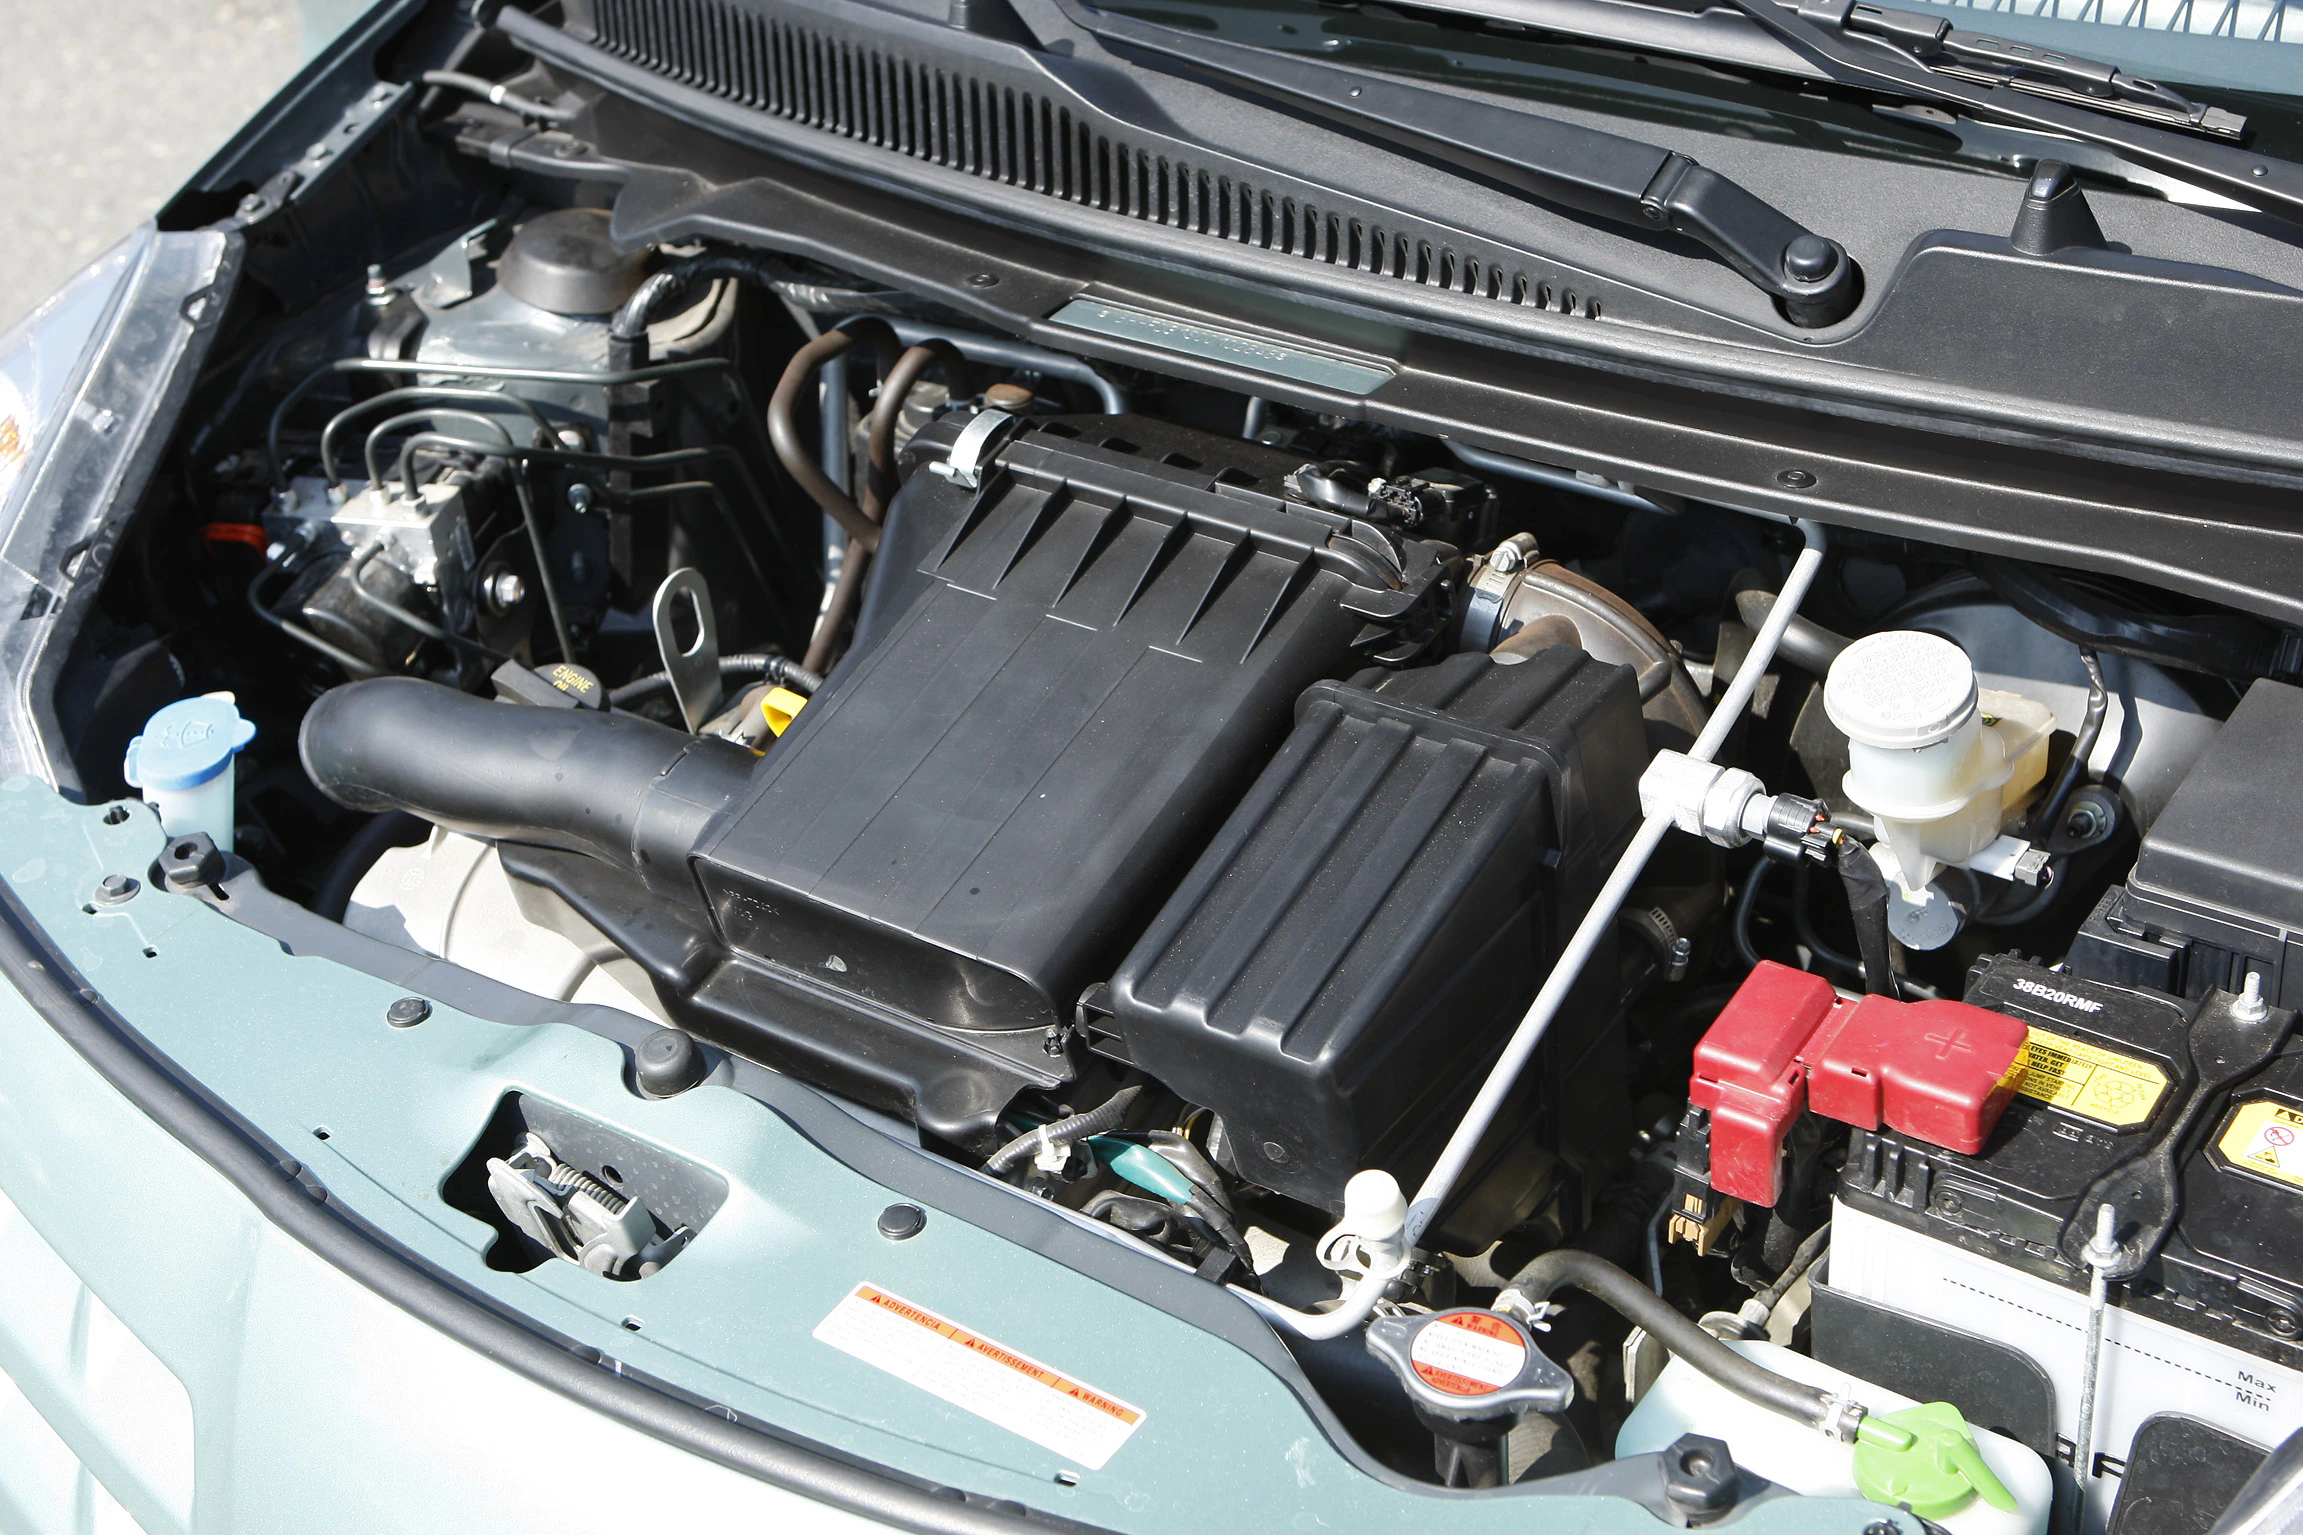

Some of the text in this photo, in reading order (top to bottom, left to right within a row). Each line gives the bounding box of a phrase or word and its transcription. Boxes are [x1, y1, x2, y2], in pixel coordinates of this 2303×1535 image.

[552, 664, 594, 694] ENGINE
[2013, 978, 2104, 1014] 38B20RMF
[2030, 1045, 2048, 1055] EYES
[2031, 1061, 2049, 1070] HELP
[883, 1299, 941, 1330] ADVERTENCIA
[977, 1343, 1044, 1379] AVERTISSEMENT
[2237, 1370, 2277, 1393] Max
[1082, 1388, 1124, 1417] WARNING
[2235, 1391, 2270, 1412] Min
